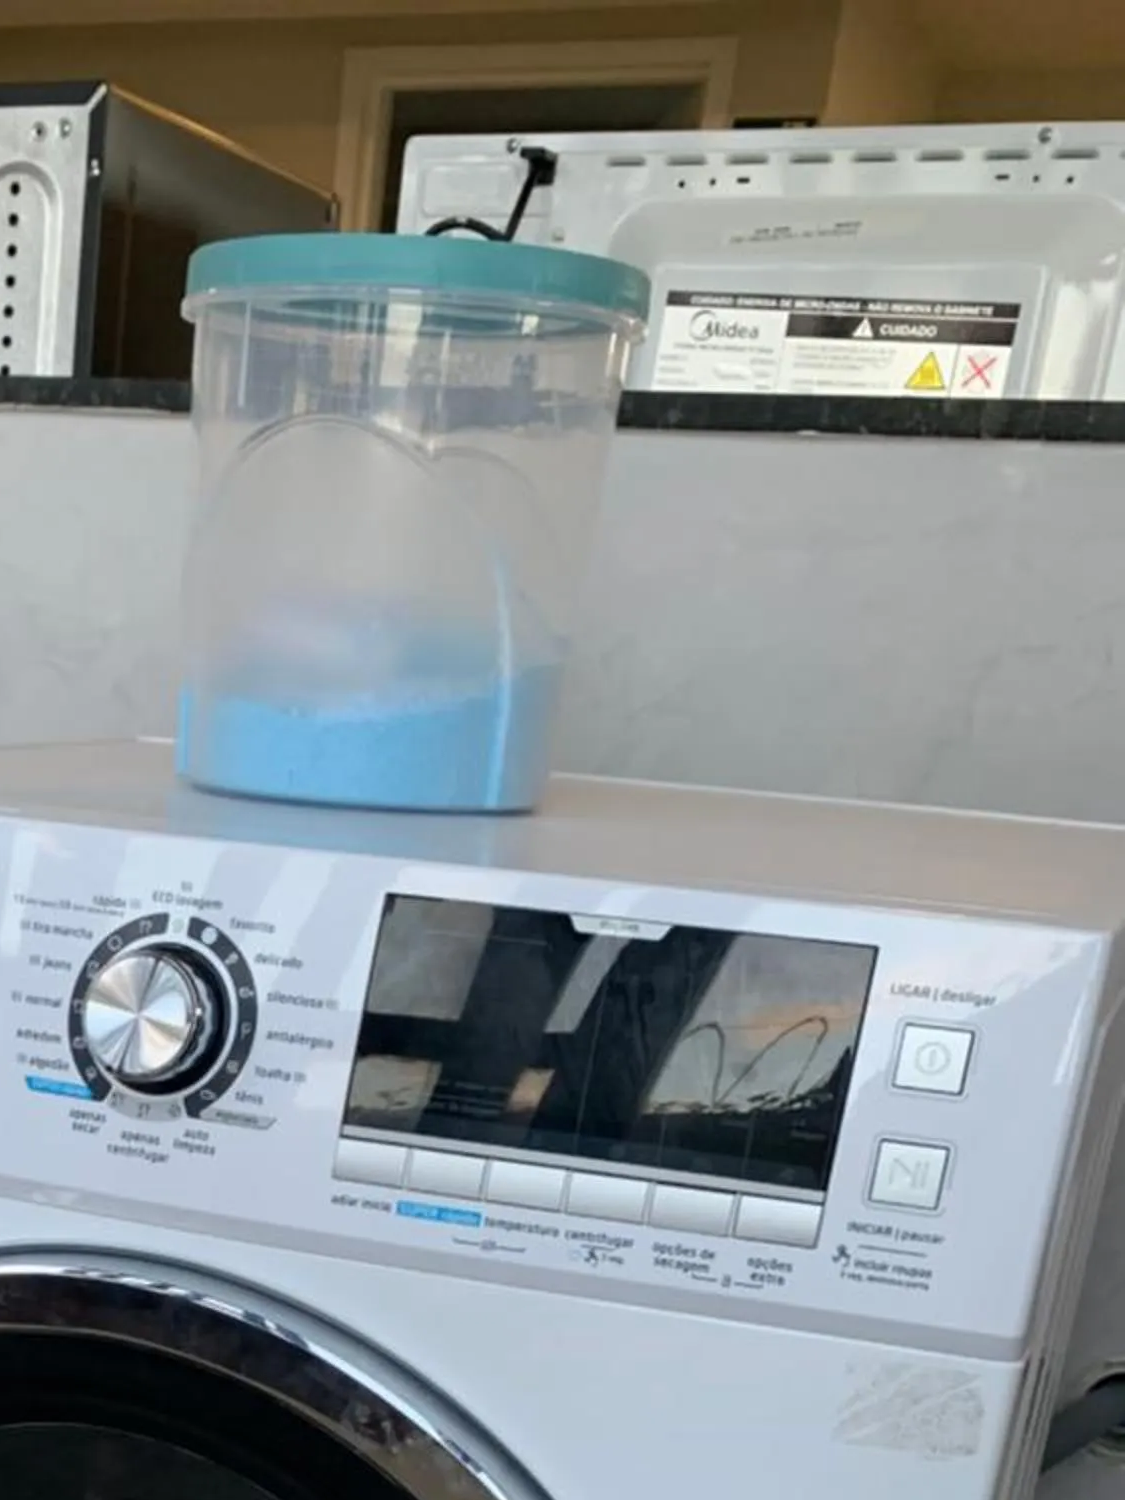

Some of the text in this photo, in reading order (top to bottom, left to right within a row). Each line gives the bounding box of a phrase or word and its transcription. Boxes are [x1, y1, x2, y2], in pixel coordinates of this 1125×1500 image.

[689, 309, 760, 341] Midea
[879, 323, 938, 338] CUIDADO
[889, 981, 931, 1000] LIGAR
[940, 988, 997, 1008] desligar
[484, 1215, 560, 1238] temperatura
[846, 1220, 893, 1237] INICIAR
[900, 1229, 946, 1245] pausar
[563, 1227, 635, 1250] centrifugar
[651, 1240, 716, 1260] opções de
[653, 1255, 711, 1274] secagem
[746, 1255, 794, 1274] opções
[749, 1272, 786, 1287] extra
